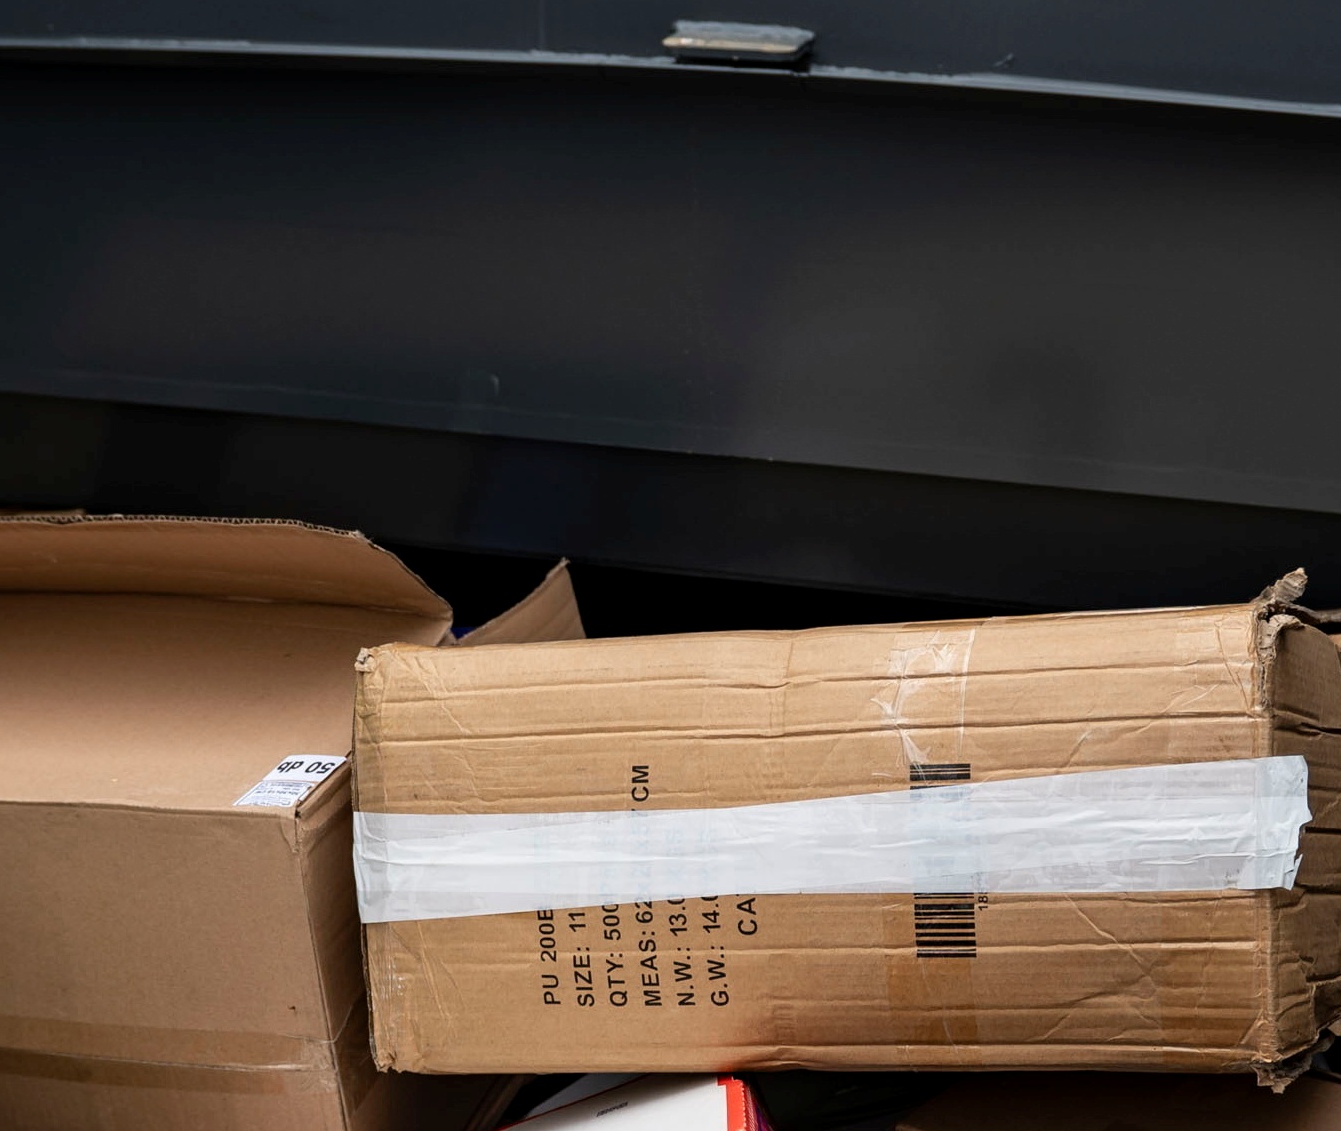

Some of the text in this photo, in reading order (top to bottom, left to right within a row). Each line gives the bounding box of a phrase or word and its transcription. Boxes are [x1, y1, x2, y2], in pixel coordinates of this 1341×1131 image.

[305, 761, 335, 774] 50
[631, 765, 649, 802] CM
[736, 894, 758, 935] CA
[541, 974, 561, 1005] PU
[573, 946, 595, 1007] SIZE:
[605, 952, 628, 1007] QTY:
[639, 930, 662, 1007] MEAS:
[674, 946, 696, 1006] N.W.:
[707, 944, 729, 1007] G.W.:
